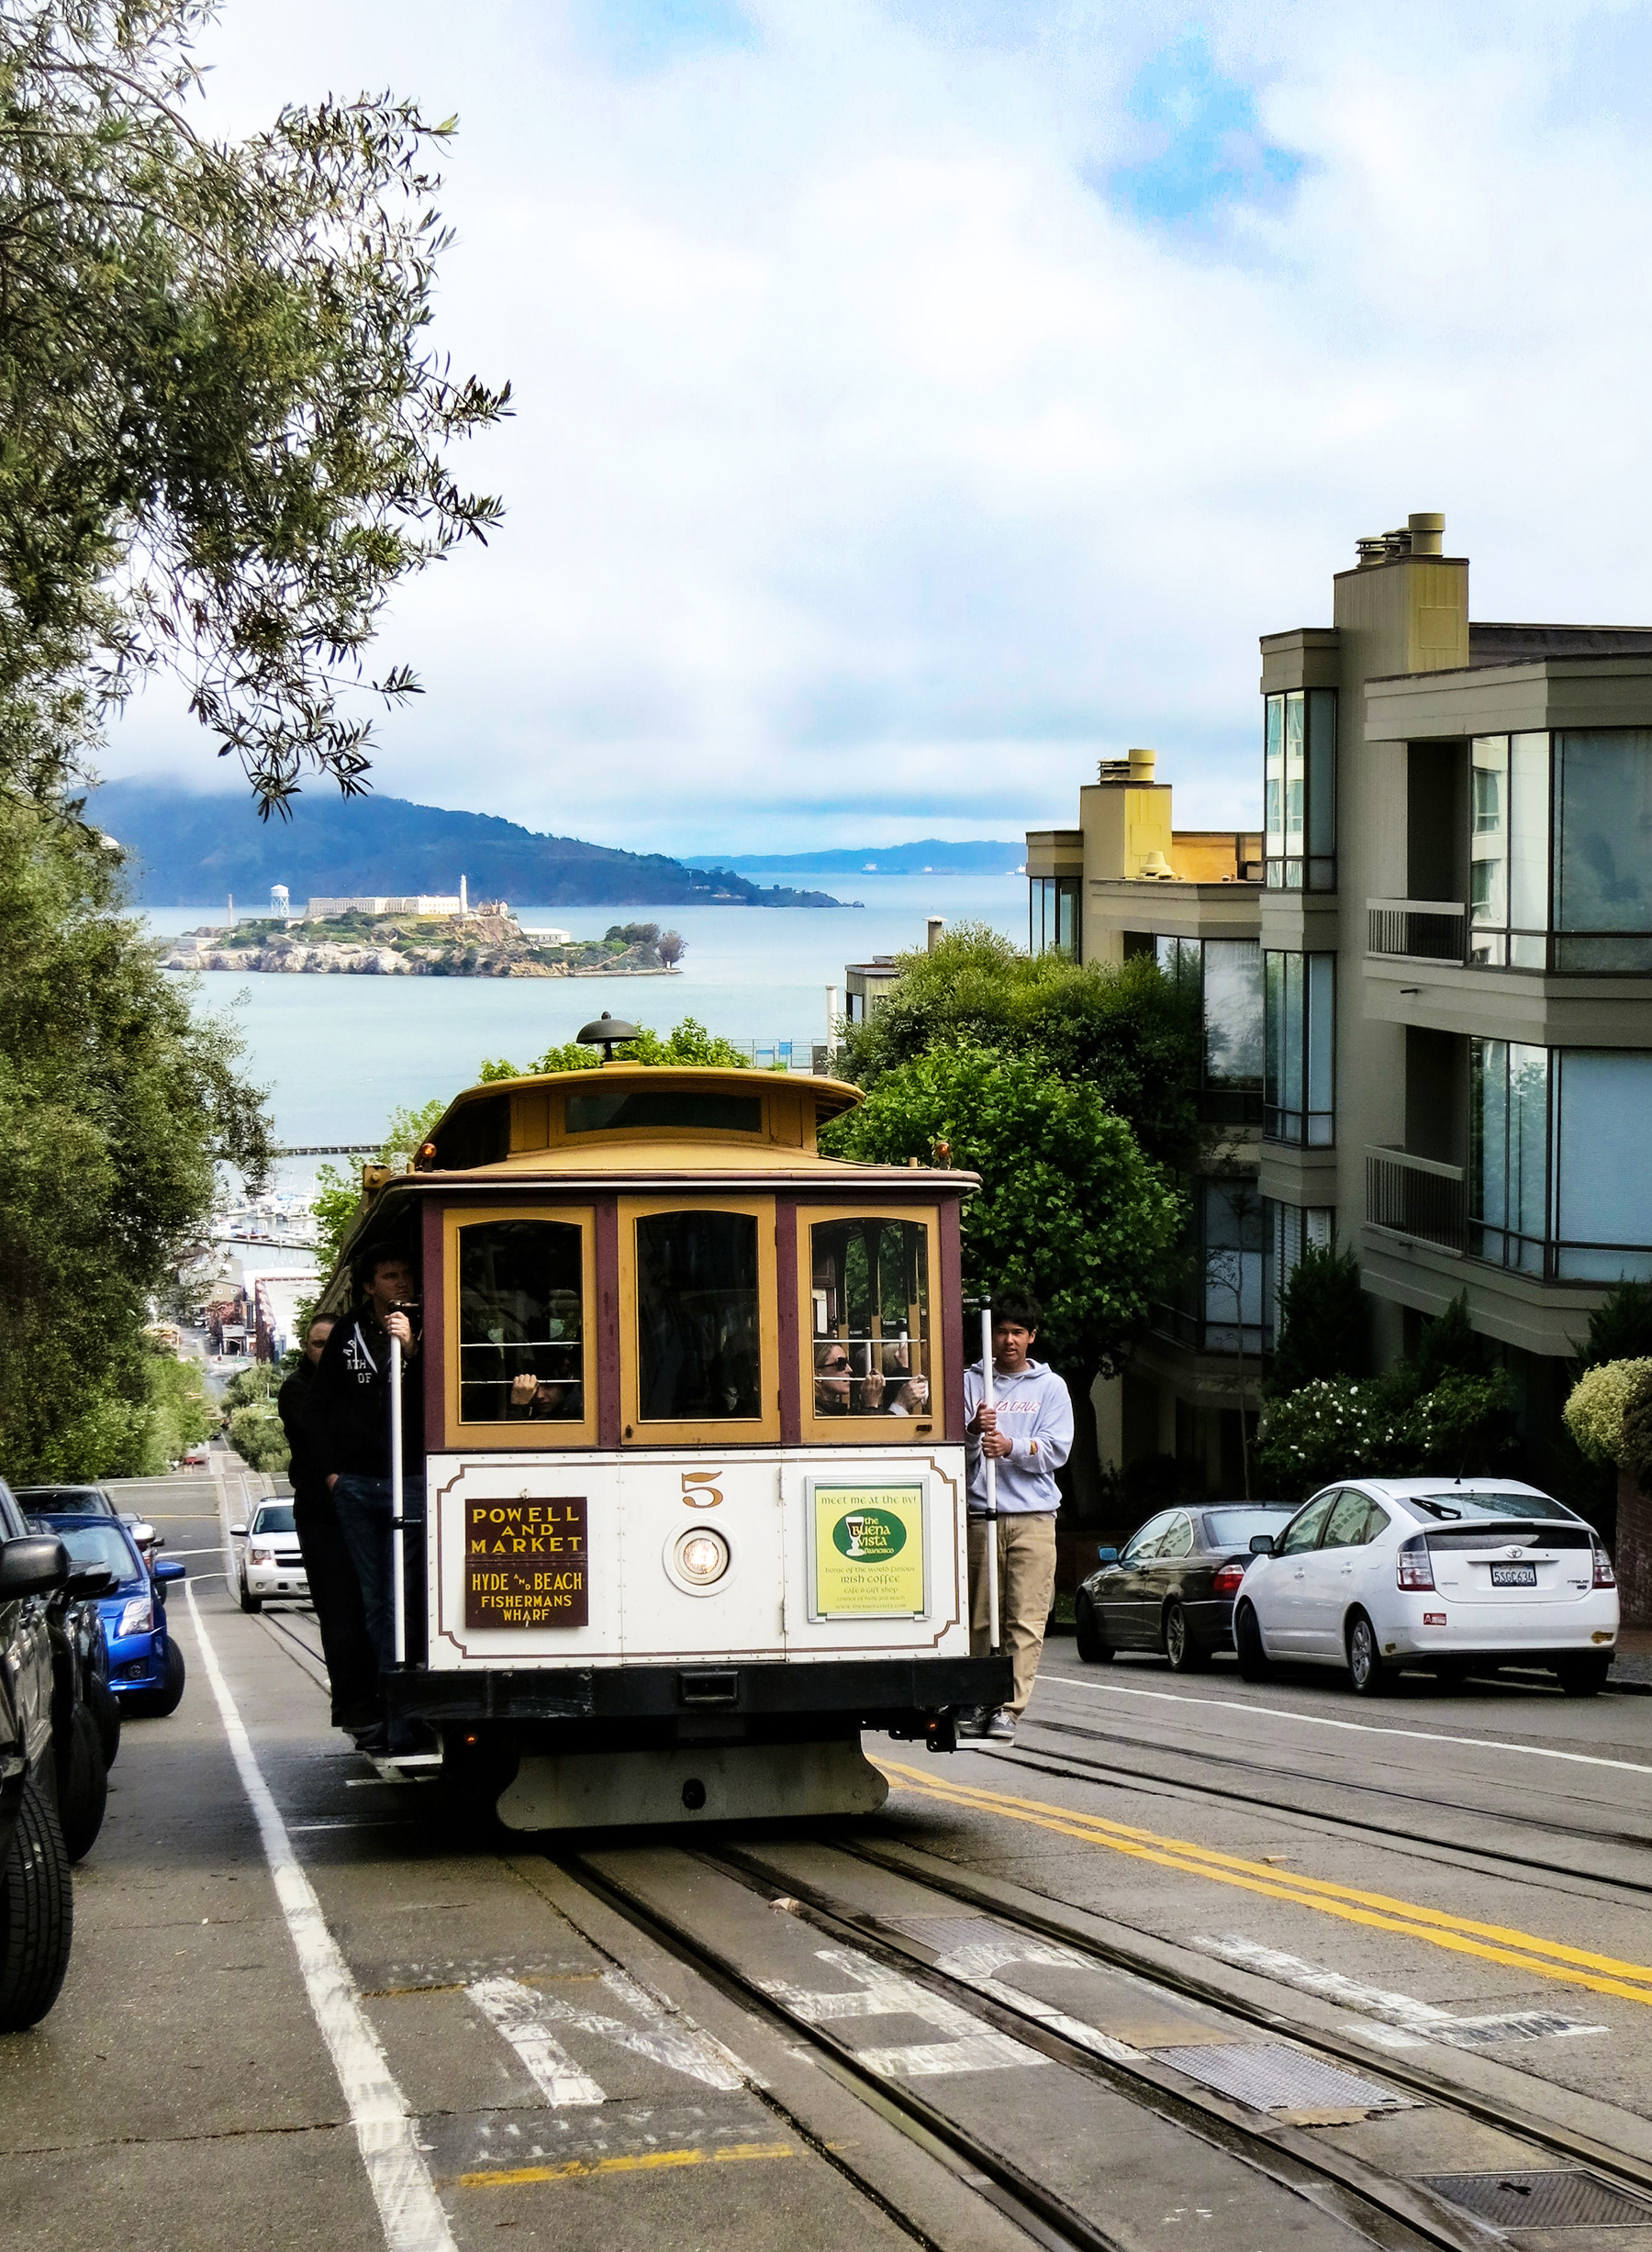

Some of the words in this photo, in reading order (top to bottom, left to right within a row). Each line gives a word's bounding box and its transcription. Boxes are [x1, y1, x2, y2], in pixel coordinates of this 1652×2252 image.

[357, 1373, 373, 1384] OF
[1009, 1400, 1042, 1412] CRUZ
[681, 1470, 724, 1509] 5
[882, 1495, 899, 1504] the
[472, 1506, 580, 1524] POWELL
[501, 1523, 554, 1536] AND
[471, 1536, 582, 1554] MARKET
[472, 1573, 509, 1591] HYDE
[513, 1574, 531, 1590] AND
[534, 1572, 583, 1590] BEACH
[866, 1574, 900, 1584] coffee
[481, 1594, 573, 1608] FISHERMANS
[503, 1609, 551, 1622] WHARF
